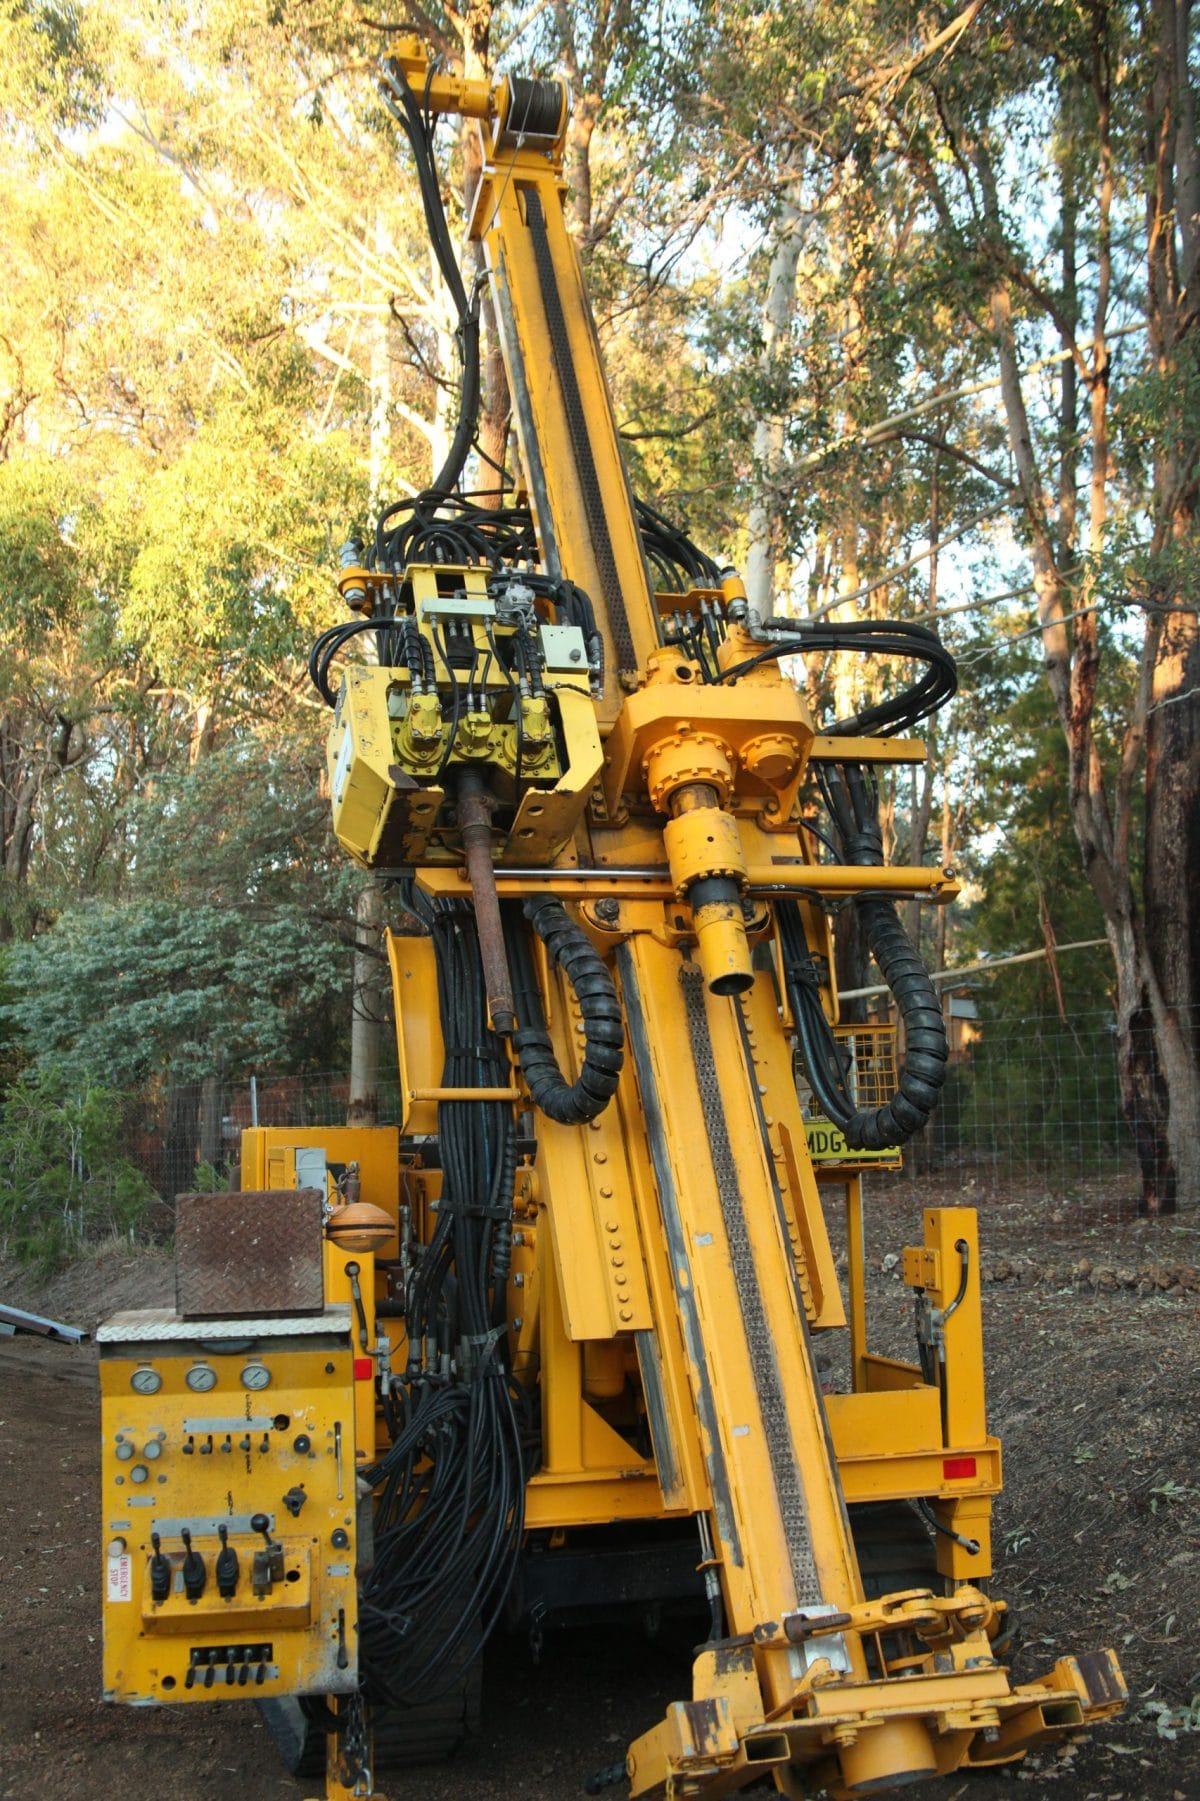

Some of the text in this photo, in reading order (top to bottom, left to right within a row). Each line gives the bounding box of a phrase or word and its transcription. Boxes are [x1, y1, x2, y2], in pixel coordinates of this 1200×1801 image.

[804, 1130, 853, 1153] MDG
[110, 1568, 119, 1586] STOP
[120, 1556, 129, 1598] EMERGENCY
